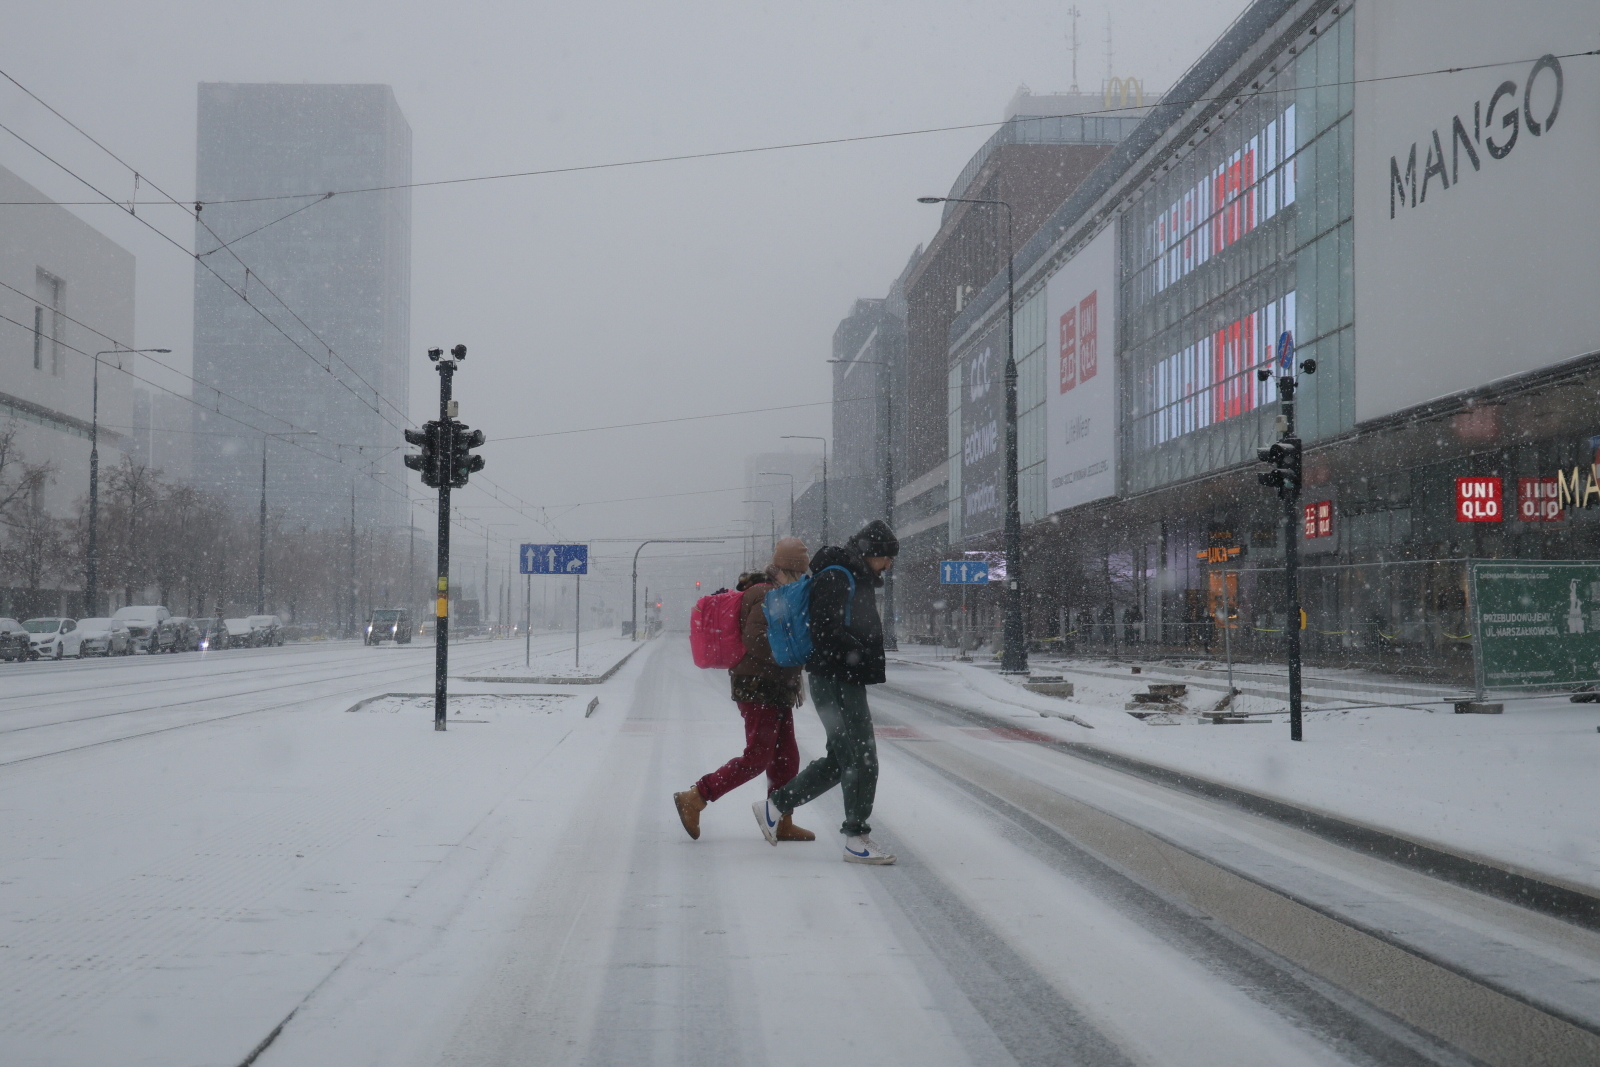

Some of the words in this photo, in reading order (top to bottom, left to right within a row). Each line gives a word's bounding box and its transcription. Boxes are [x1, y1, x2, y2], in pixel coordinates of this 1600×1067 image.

[1390, 54, 1564, 220] MANGO
[1081, 303, 1094, 337] UNI
[1081, 339, 1095, 376] QLO
[1461, 482, 1494, 498] UNI
[1462, 501, 1498, 519] QLO
[1483, 613, 1551, 623] PRZEBUDOWUJEMY
